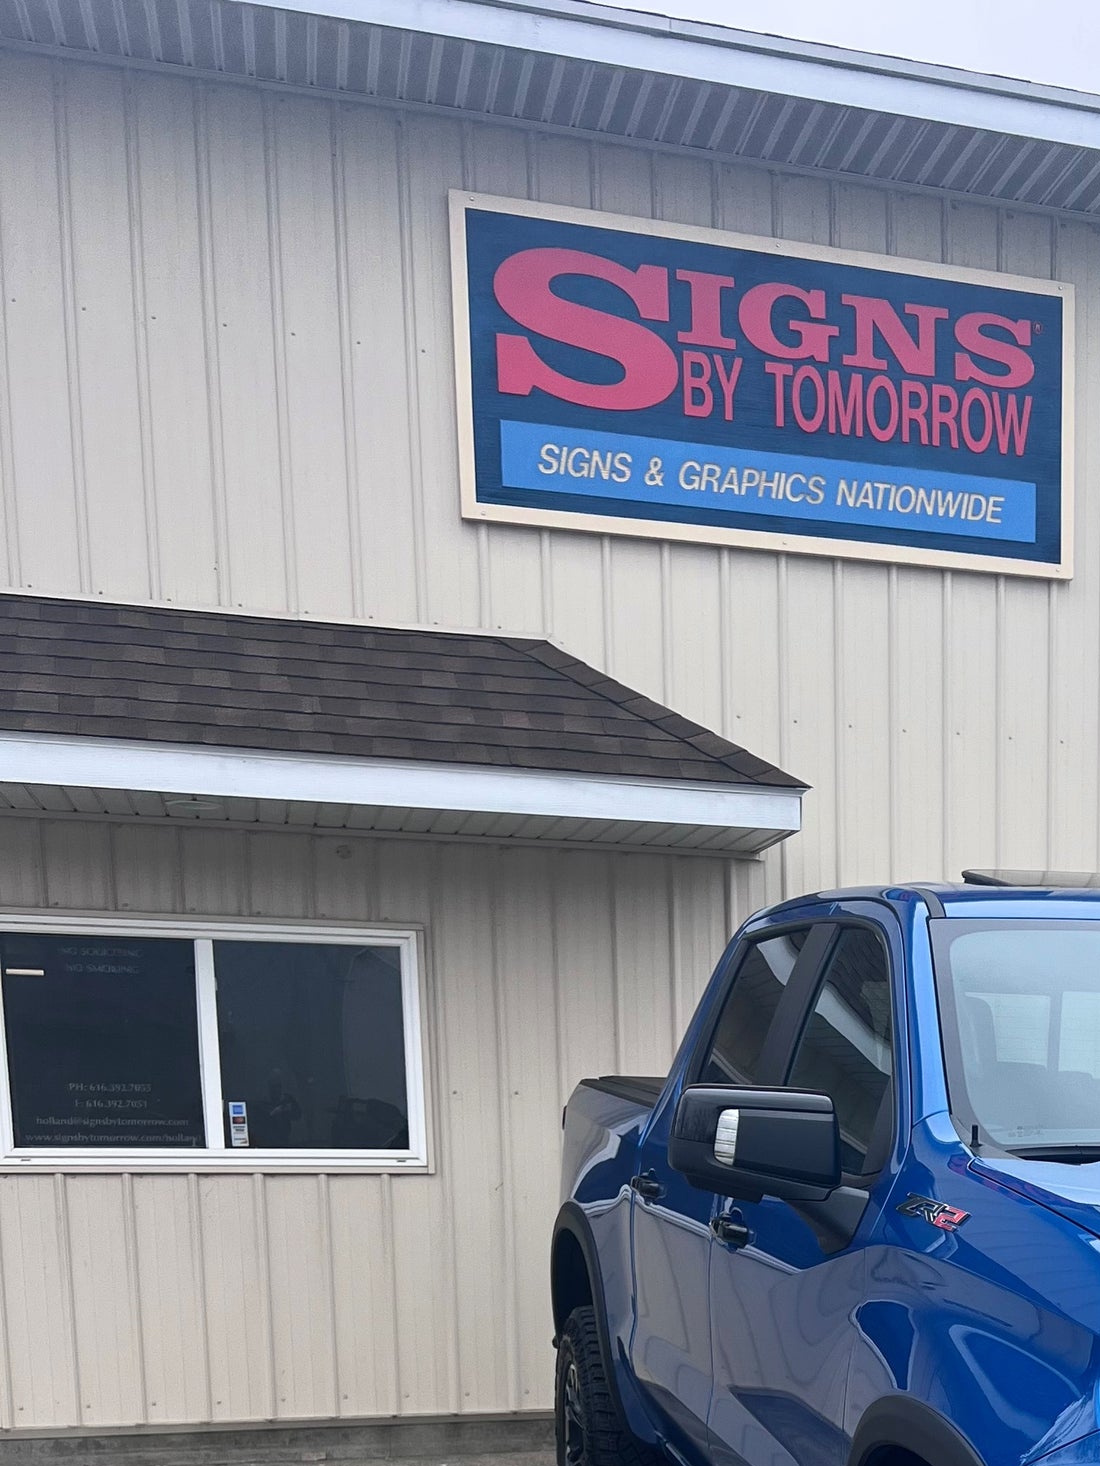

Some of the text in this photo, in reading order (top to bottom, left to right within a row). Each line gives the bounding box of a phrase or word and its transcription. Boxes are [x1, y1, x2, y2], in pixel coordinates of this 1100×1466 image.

[683, 350, 1033, 457] BY TOMORROW
[538, 442, 1006, 525] SIGNS & GRAPHICS NATIONWIDE
